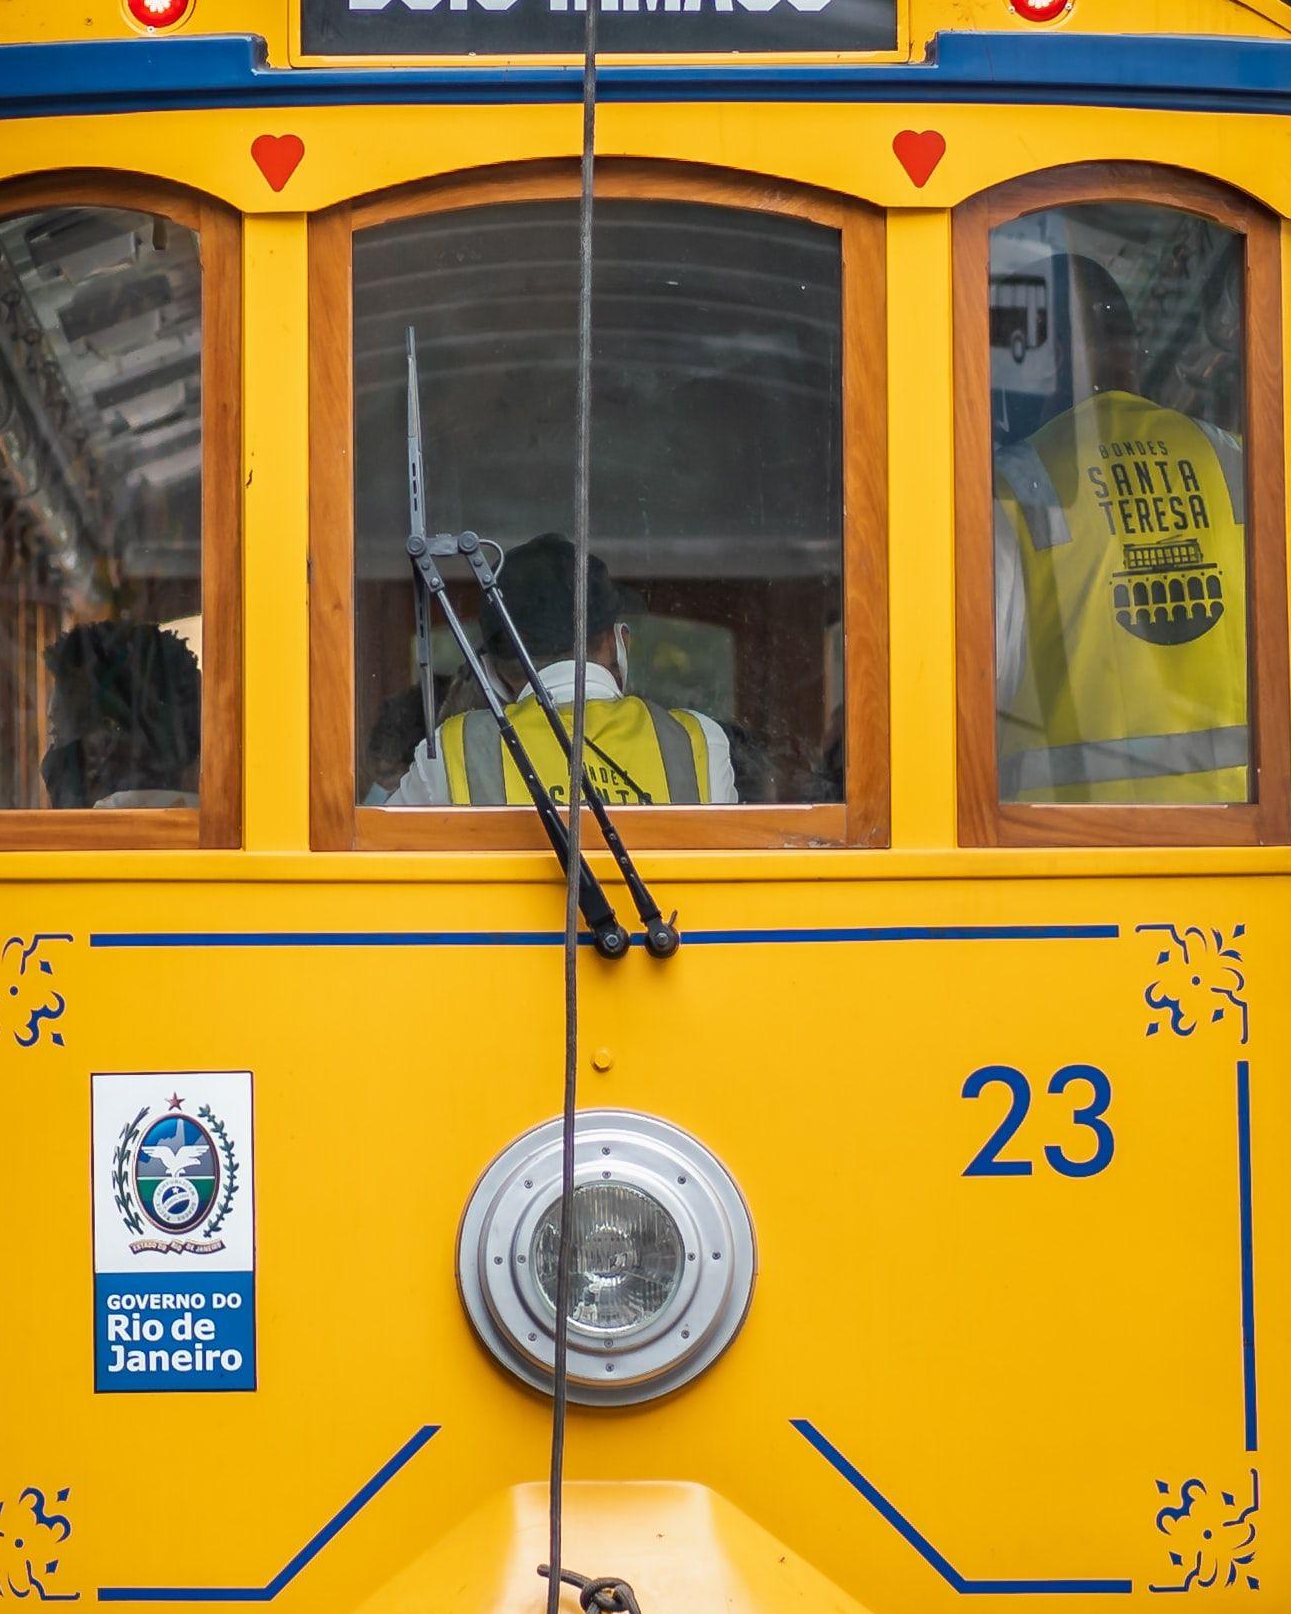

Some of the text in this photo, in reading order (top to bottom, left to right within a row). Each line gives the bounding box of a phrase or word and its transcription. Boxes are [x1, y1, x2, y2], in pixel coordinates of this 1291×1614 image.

[1099, 440, 1169, 459] BONDES
[1088, 459, 1201, 498] SANTA
[1099, 495, 1210, 535] TERESA
[960, 1064, 1115, 1178] 23
[107, 1292, 243, 1311] GOVERNO DO
[107, 1311, 216, 1342] Rio de
[108, 1342, 244, 1373] Janeiro
